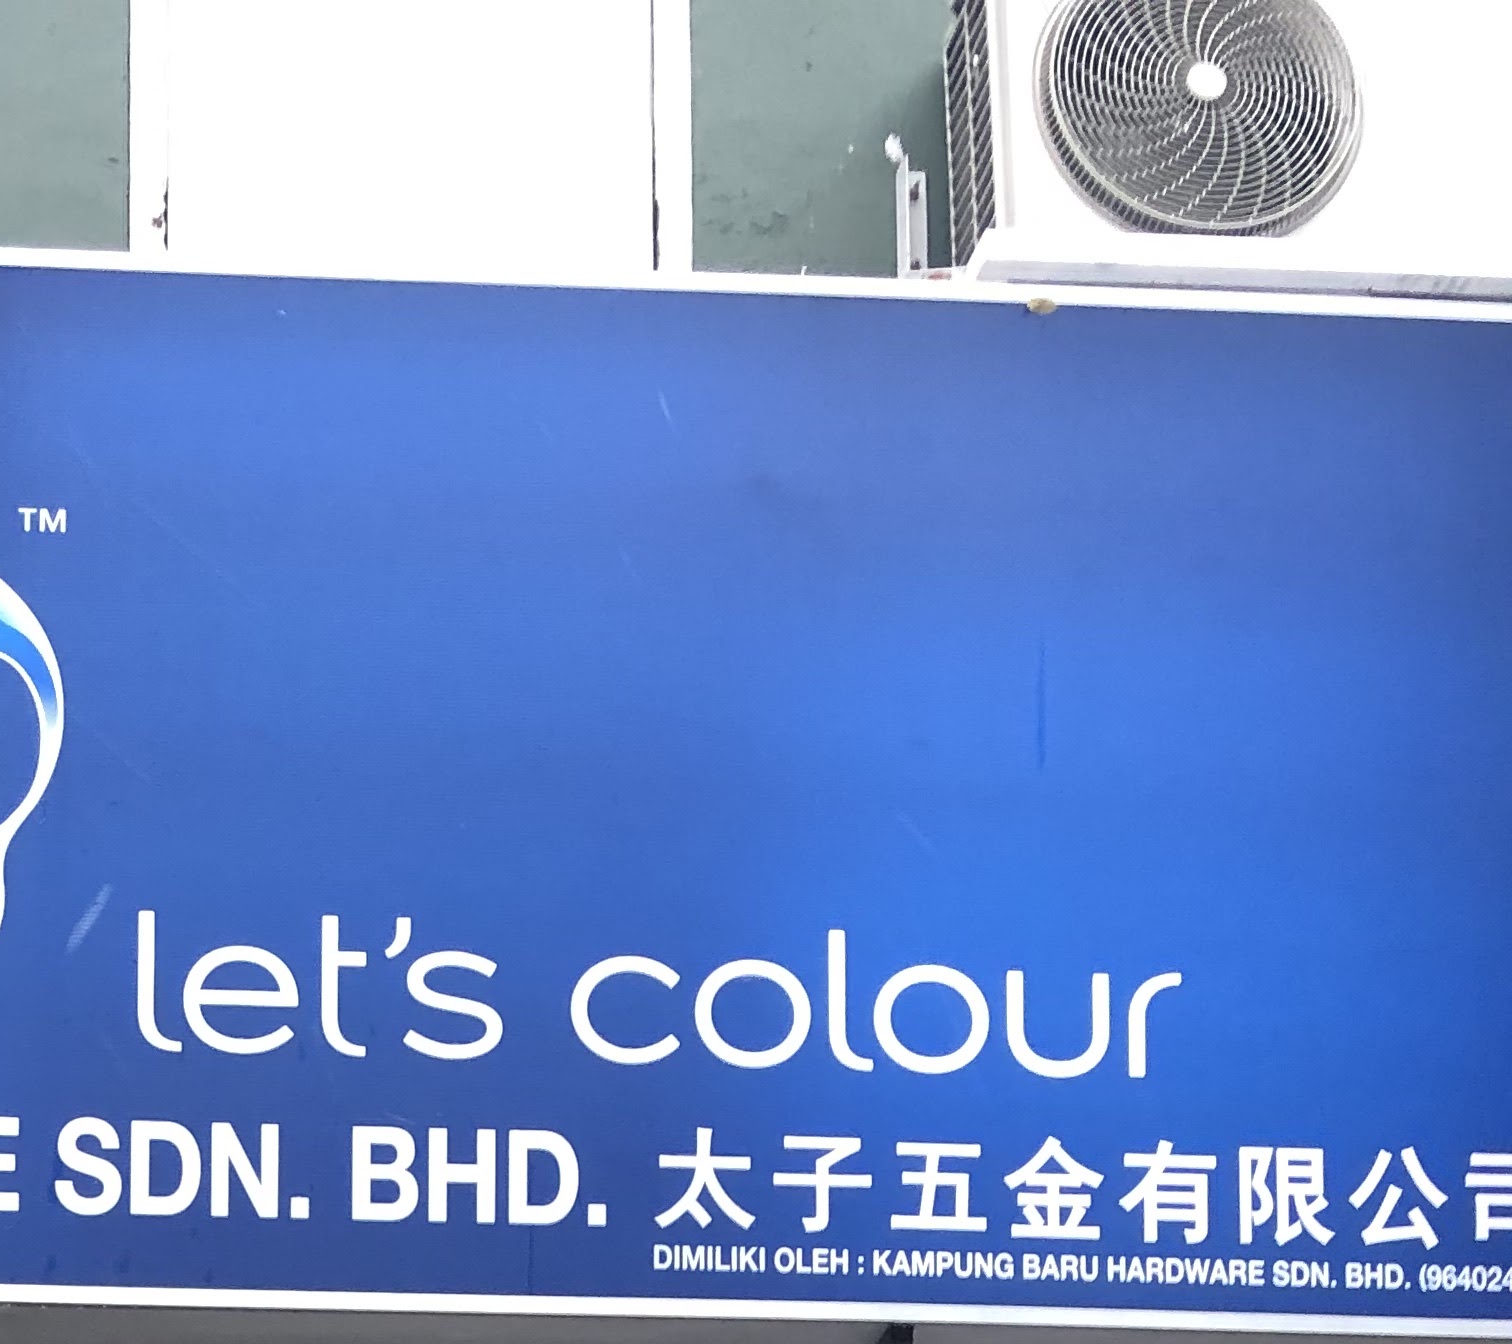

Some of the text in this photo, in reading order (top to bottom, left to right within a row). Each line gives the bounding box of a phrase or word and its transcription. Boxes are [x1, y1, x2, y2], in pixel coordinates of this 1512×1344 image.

[138, 910, 1182, 1079] let's colour
[54, 1116, 310, 1219] SDN.
[351, 1125, 607, 1227] BHD.
[653, 1244, 766, 1273] DIMILIKI
[774, 1246, 849, 1275] OLEH
[872, 1249, 1015, 1280] KAMPUNG
[1022, 1253, 1099, 1283] BARU
[1107, 1255, 1266, 1287] HARDWARE
[1272, 1260, 1338, 1289] SDN.
[1345, 1261, 1412, 1291] BHD.
